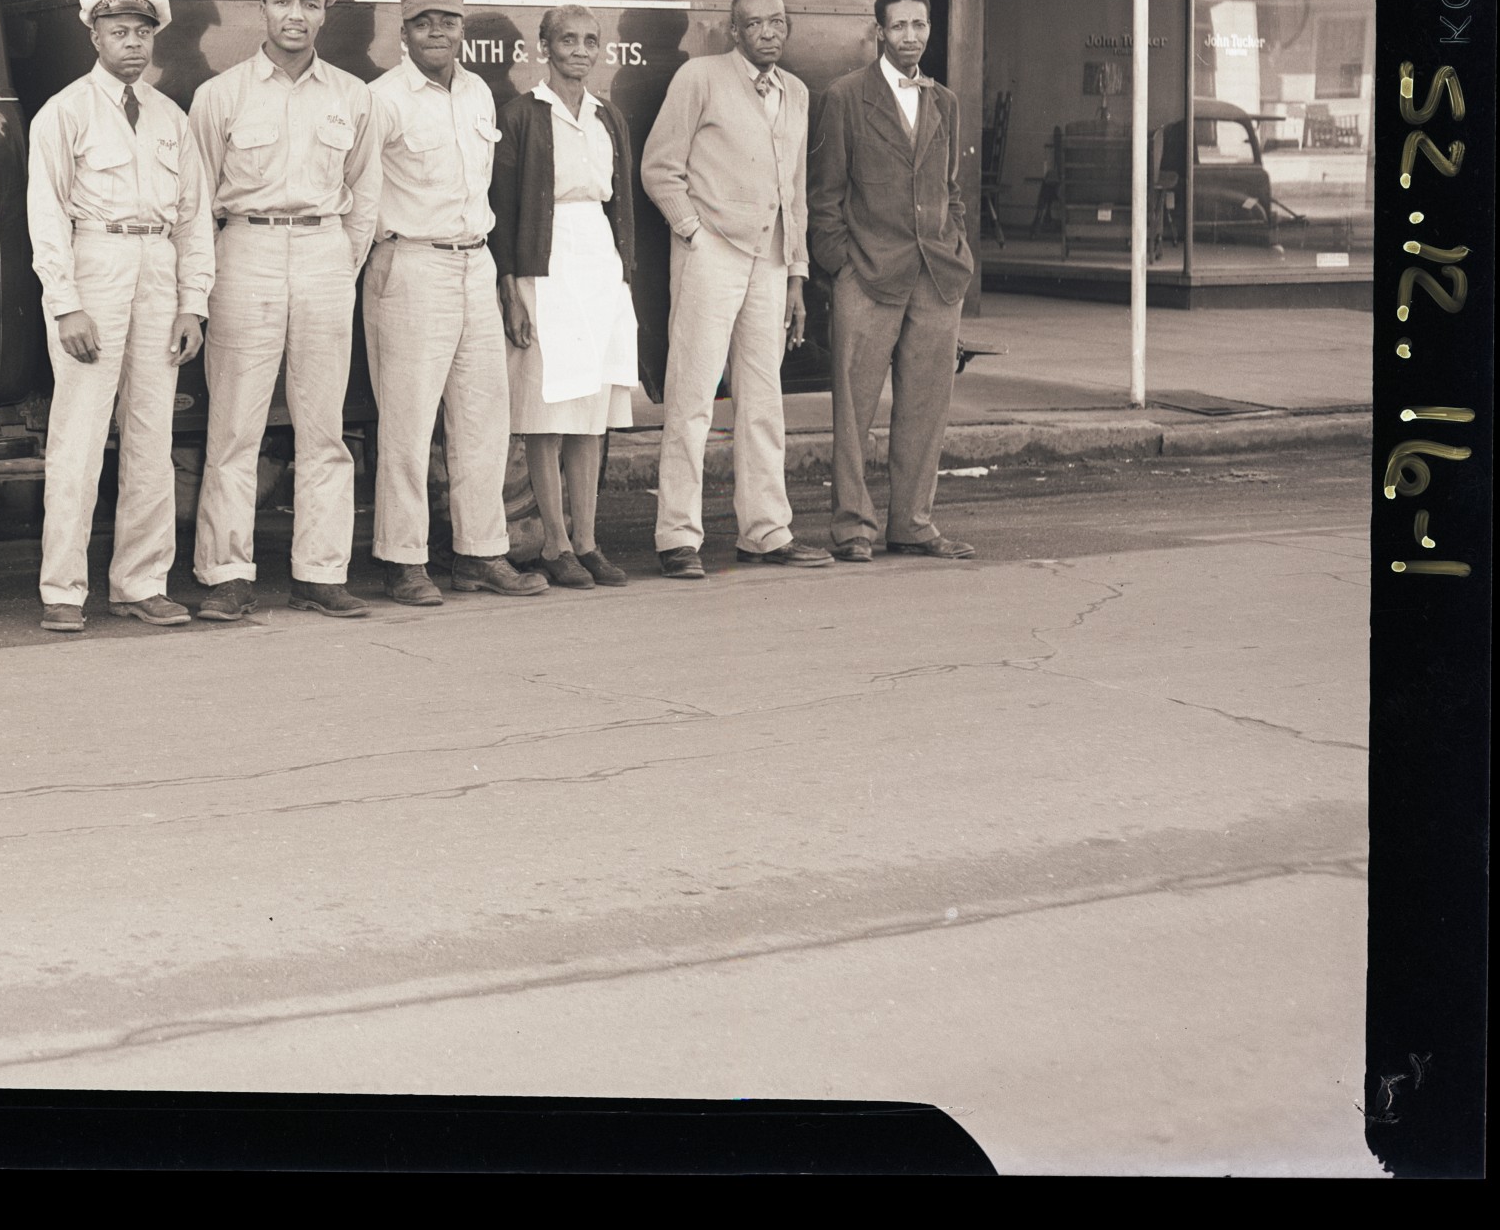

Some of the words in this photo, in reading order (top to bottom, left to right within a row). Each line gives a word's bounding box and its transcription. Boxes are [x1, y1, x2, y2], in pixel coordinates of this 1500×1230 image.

[1085, 34, 1118, 48] John
[1204, 33, 1230, 48] John
[1230, 33, 1266, 49] Tucker
[512, 39, 529, 63] &
[605, 42, 647, 66] STS.
